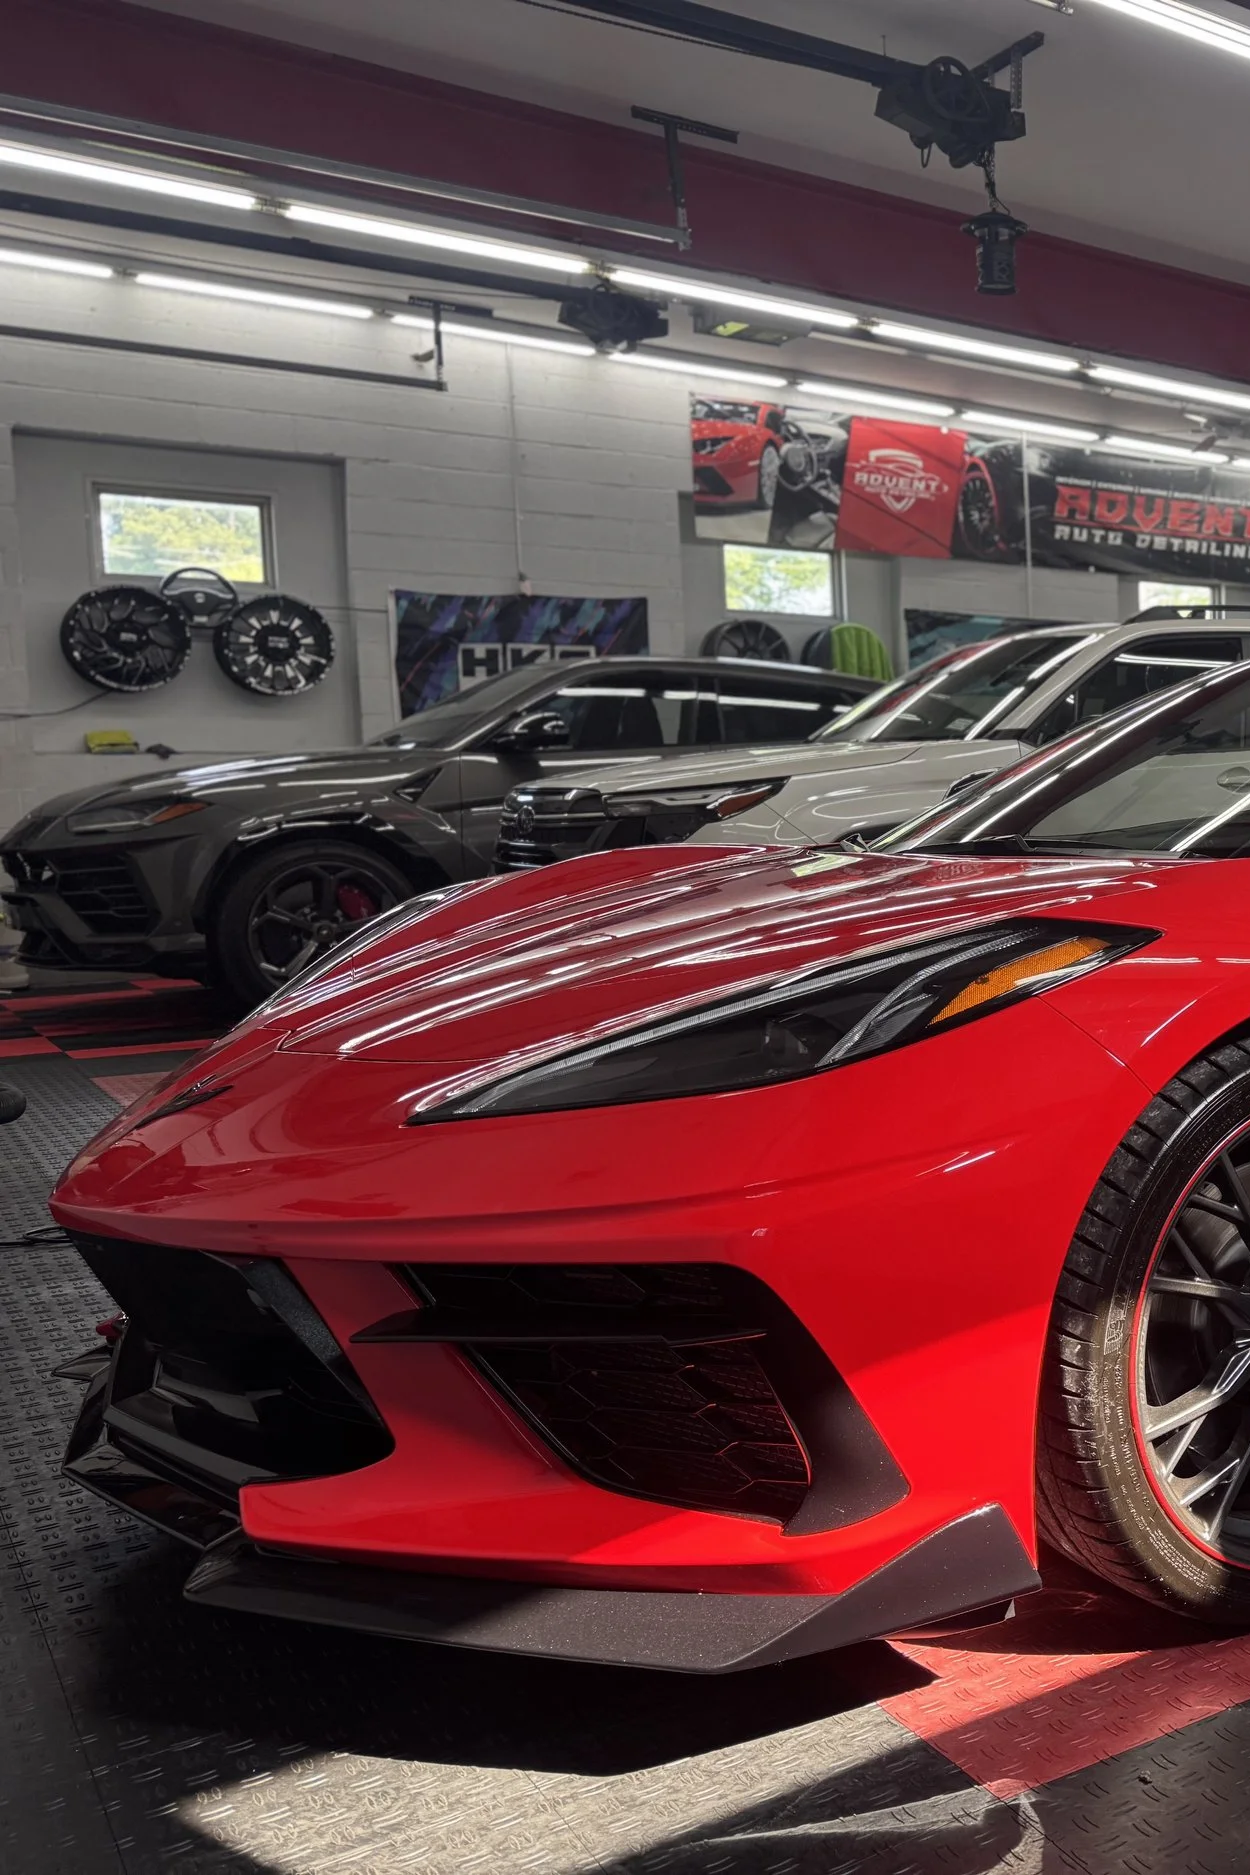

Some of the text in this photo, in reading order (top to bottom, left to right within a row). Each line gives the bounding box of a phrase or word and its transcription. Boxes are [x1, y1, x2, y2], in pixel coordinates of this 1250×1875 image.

[853, 471, 940, 494] ADVENT
[1054, 525, 1123, 546] AUTO
[459, 643, 596, 680] HK
